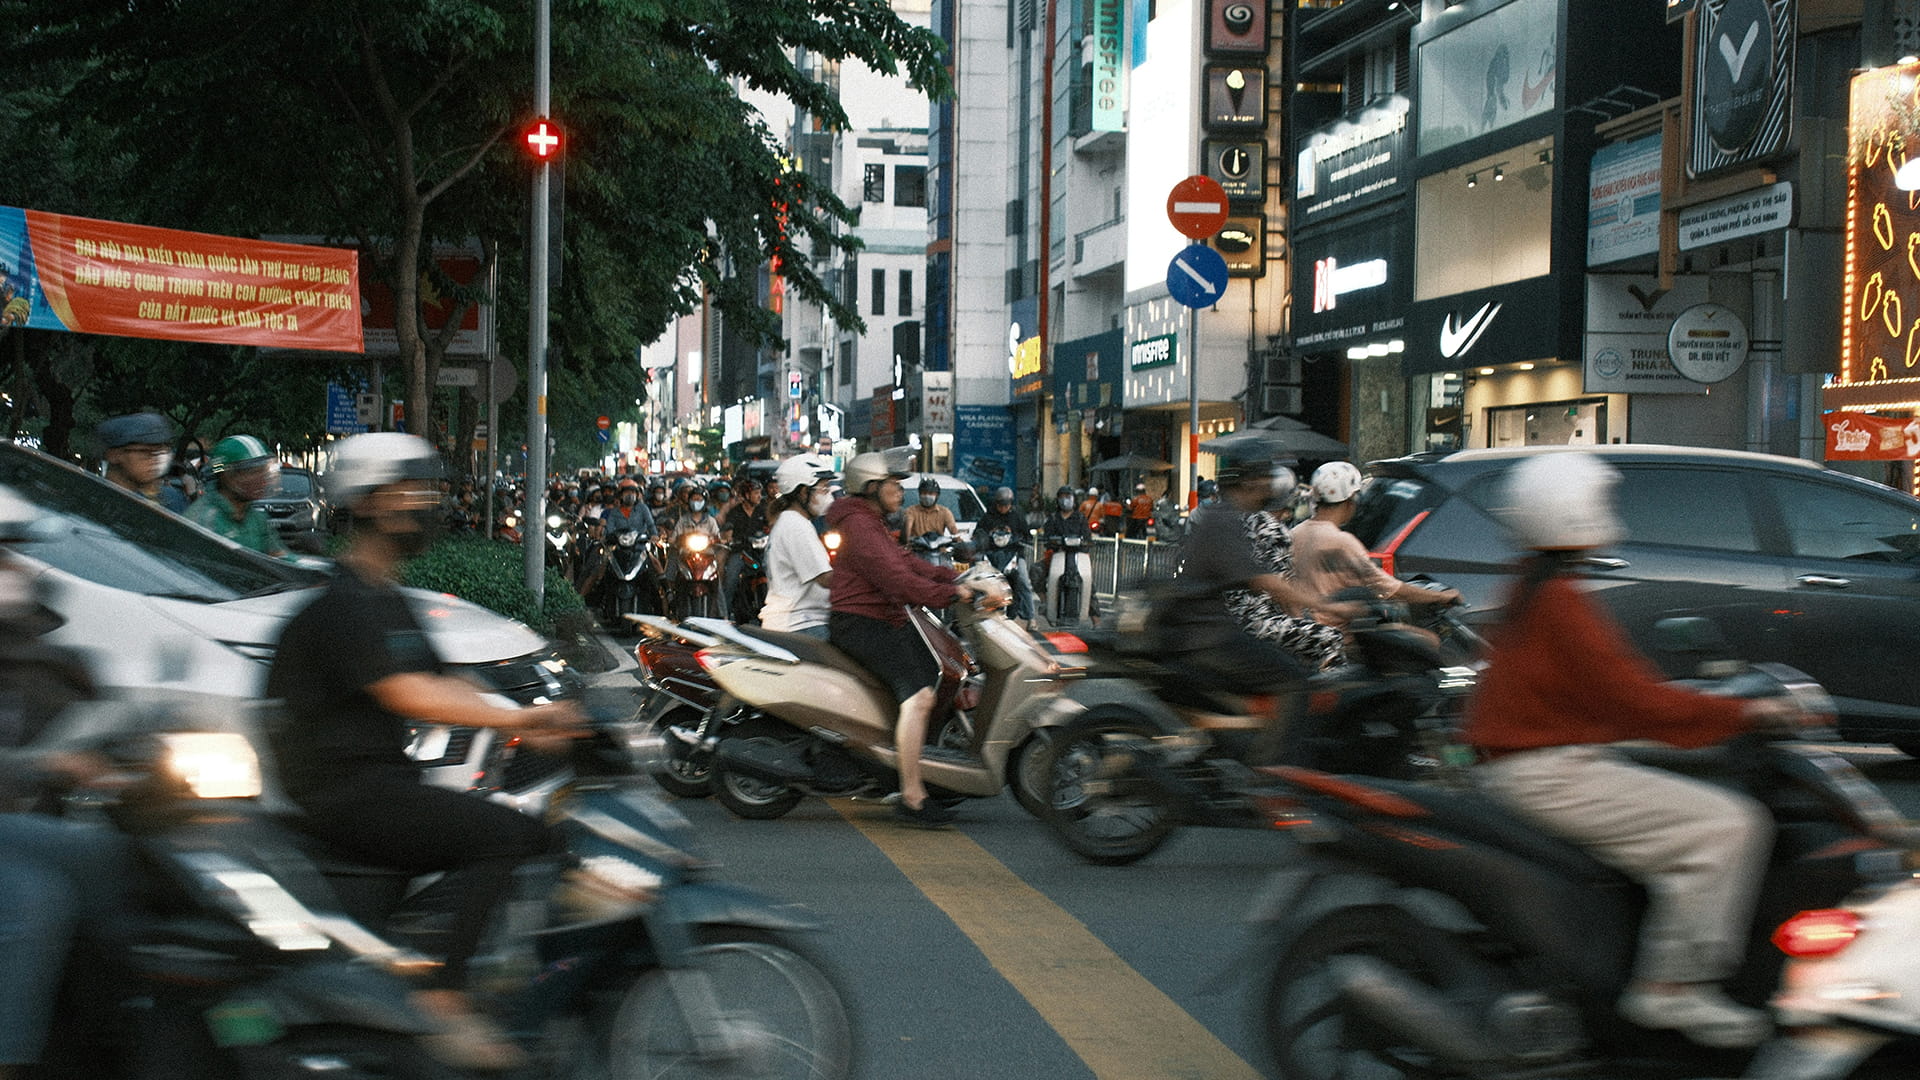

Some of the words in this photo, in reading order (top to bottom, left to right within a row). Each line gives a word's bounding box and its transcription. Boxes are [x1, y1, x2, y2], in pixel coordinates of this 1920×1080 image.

[99, 240, 121, 263] HỘI
[123, 244, 145, 265] ĐẠI
[147, 244, 174, 265] BIỂU
[175, 250, 205, 270] TOÀN
[207, 251, 238, 274] QUỐC
[239, 254, 259, 276] LẦN
[283, 263, 300, 280] XIV
[302, 262, 321, 283] CỦA
[322, 265, 350, 286] ĐẢNG
[134, 272, 165, 293] QUAN
[167, 276, 204, 299] TRỌNG
[207, 279, 234, 300] TRÊN
[235, 284, 257, 302] CON
[258, 286, 292, 306] ĐƯỜNG
[294, 289, 321, 308] PHÁT
[323, 288, 353, 311] TRIỂN
[138, 298, 163, 320] CỦA
[164, 300, 188, 322] ĐẤT
[189, 304, 219, 326] NƯỚC
[221, 307, 237, 327] VÀ
[238, 309, 261, 329] DÂN
[263, 311, 284, 333] TỘC
[286, 315, 299, 332] TA
